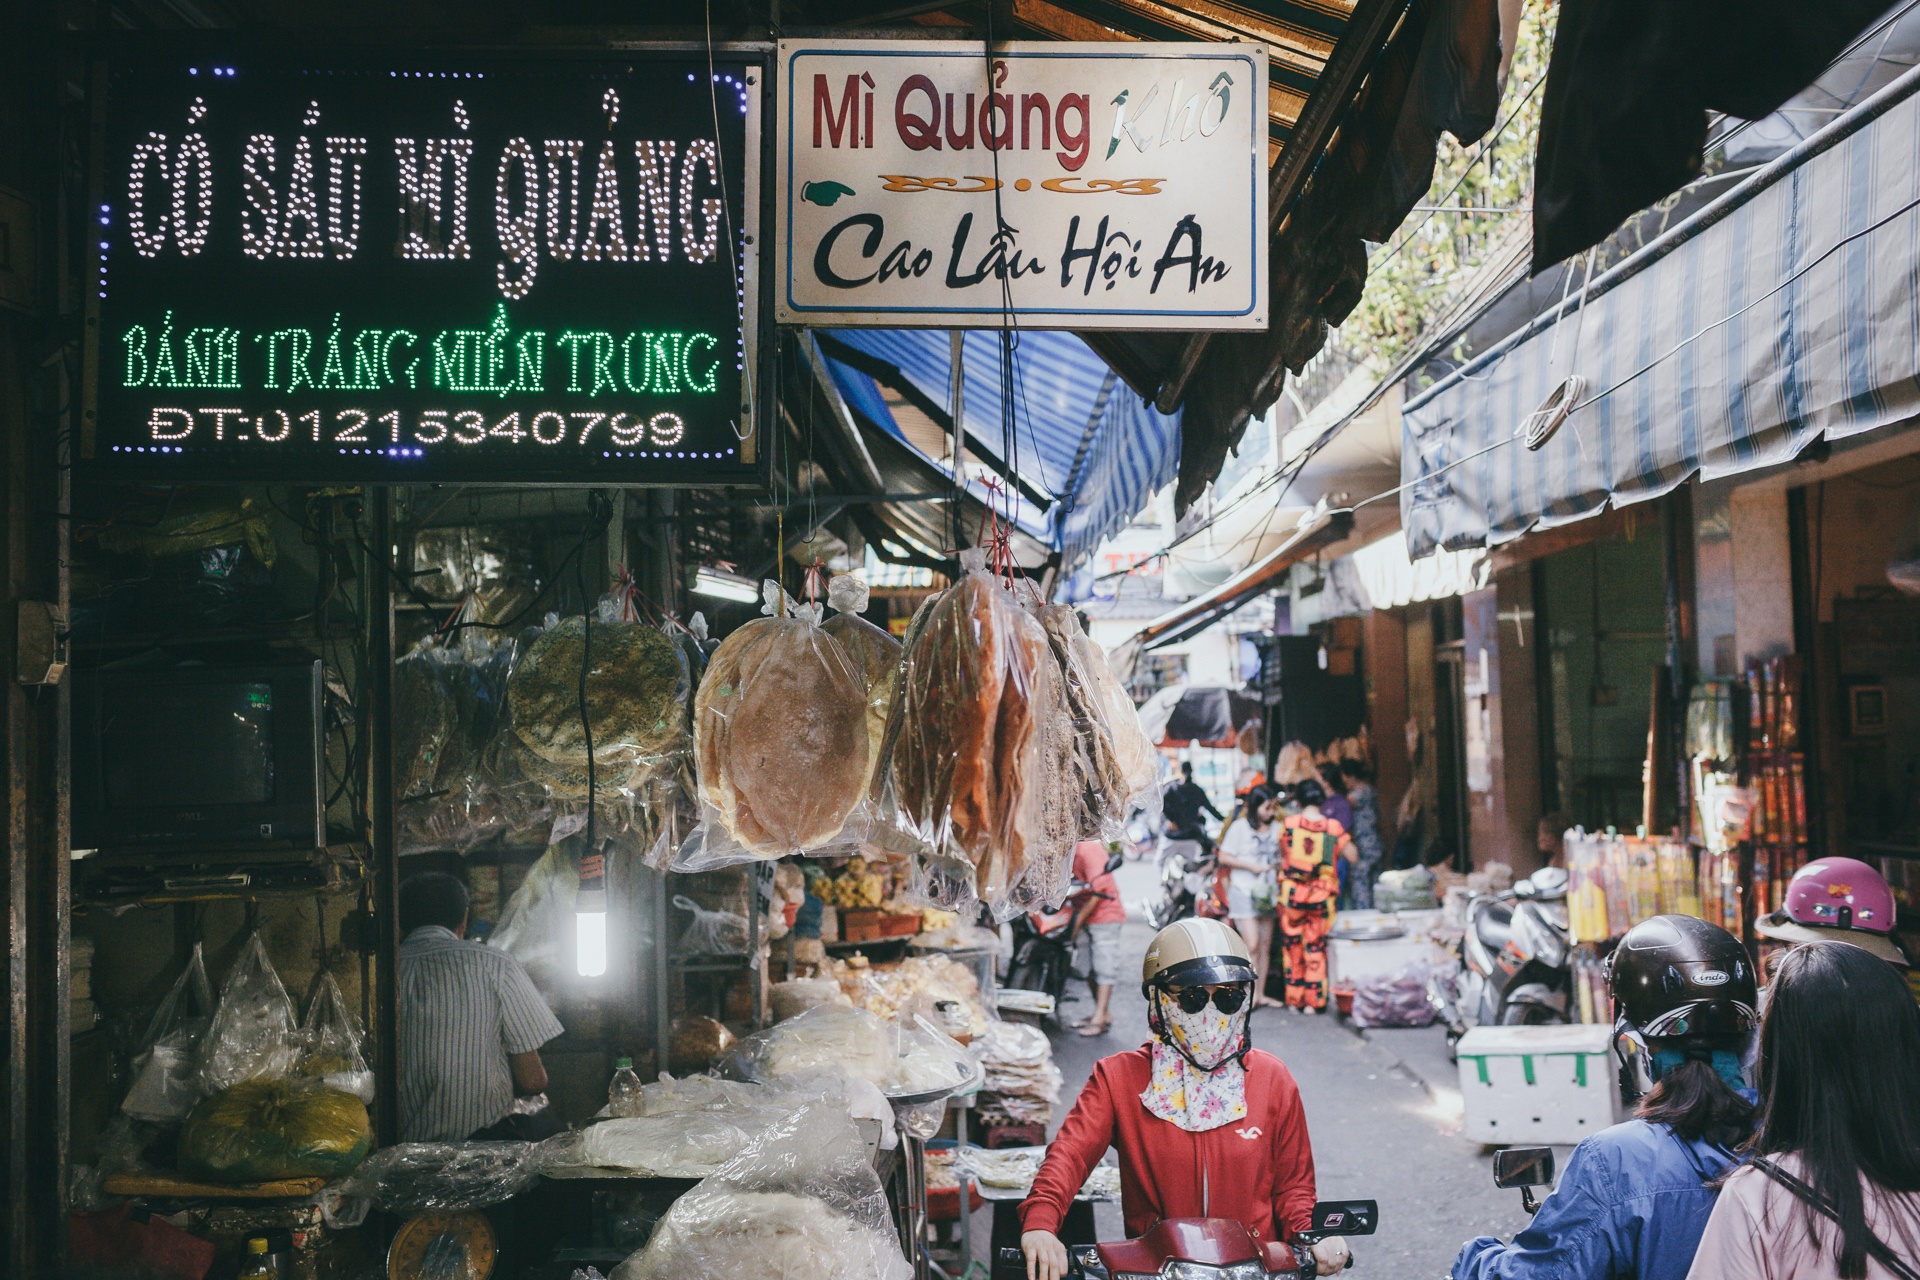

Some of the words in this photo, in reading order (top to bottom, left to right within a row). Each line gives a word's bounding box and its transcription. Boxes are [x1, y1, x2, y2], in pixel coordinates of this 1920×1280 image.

[813, 70, 877, 149] Mì
[895, 60, 1092, 172] Quảng
[1105, 71, 1235, 162] Khô
[241, 100, 367, 260] SÁU
[393, 99, 473, 259] MÌ
[496, 87, 722, 301] QUẢNG
[813, 212, 933, 290] Cao
[1060, 214, 1143, 296] Hội
[1150, 213, 1232, 295] An
[121, 309, 242, 389] BÁNH
[253, 311, 420, 394] TRÁNG
[557, 329, 721, 398] TRUNG
[147, 406, 686, 446] ĐT:01215340799
